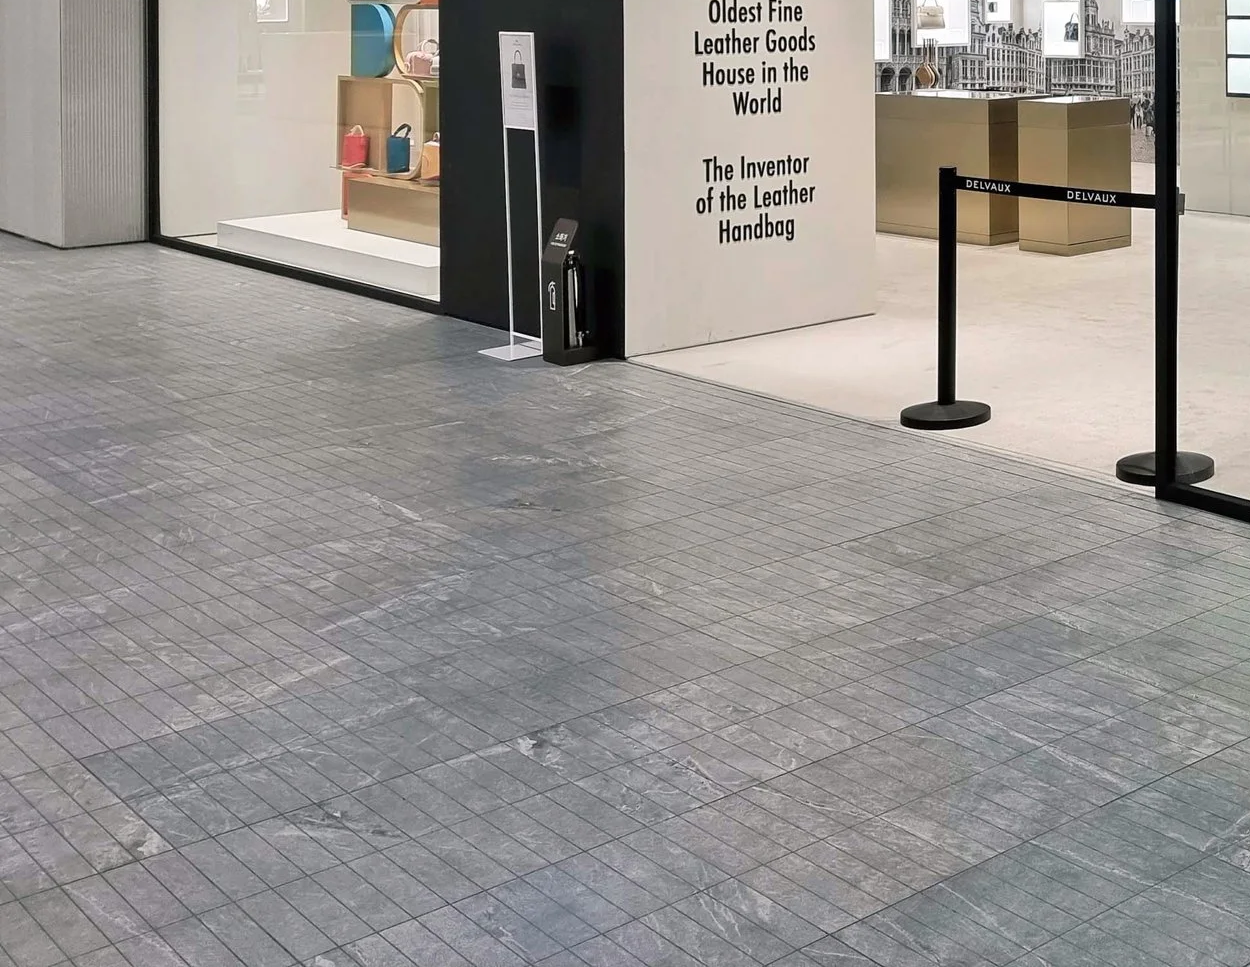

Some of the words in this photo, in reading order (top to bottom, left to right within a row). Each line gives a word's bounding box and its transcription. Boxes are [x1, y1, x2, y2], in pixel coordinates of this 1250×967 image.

[694, 28, 760, 55] Leather
[765, 26, 816, 53] Goods
[702, 61, 755, 87] House
[761, 60, 777, 84] in
[782, 56, 809, 83] the
[732, 87, 782, 116] World
[702, 155, 734, 183] The
[740, 154, 810, 182] Inventor
[695, 186, 714, 215] of
[719, 185, 747, 212] the
[754, 179, 816, 209] Leather
[966, 179, 1012, 194] DELVAUX
[1067, 190, 1117, 204] DELVAUX
[719, 212, 795, 244] Handbag
